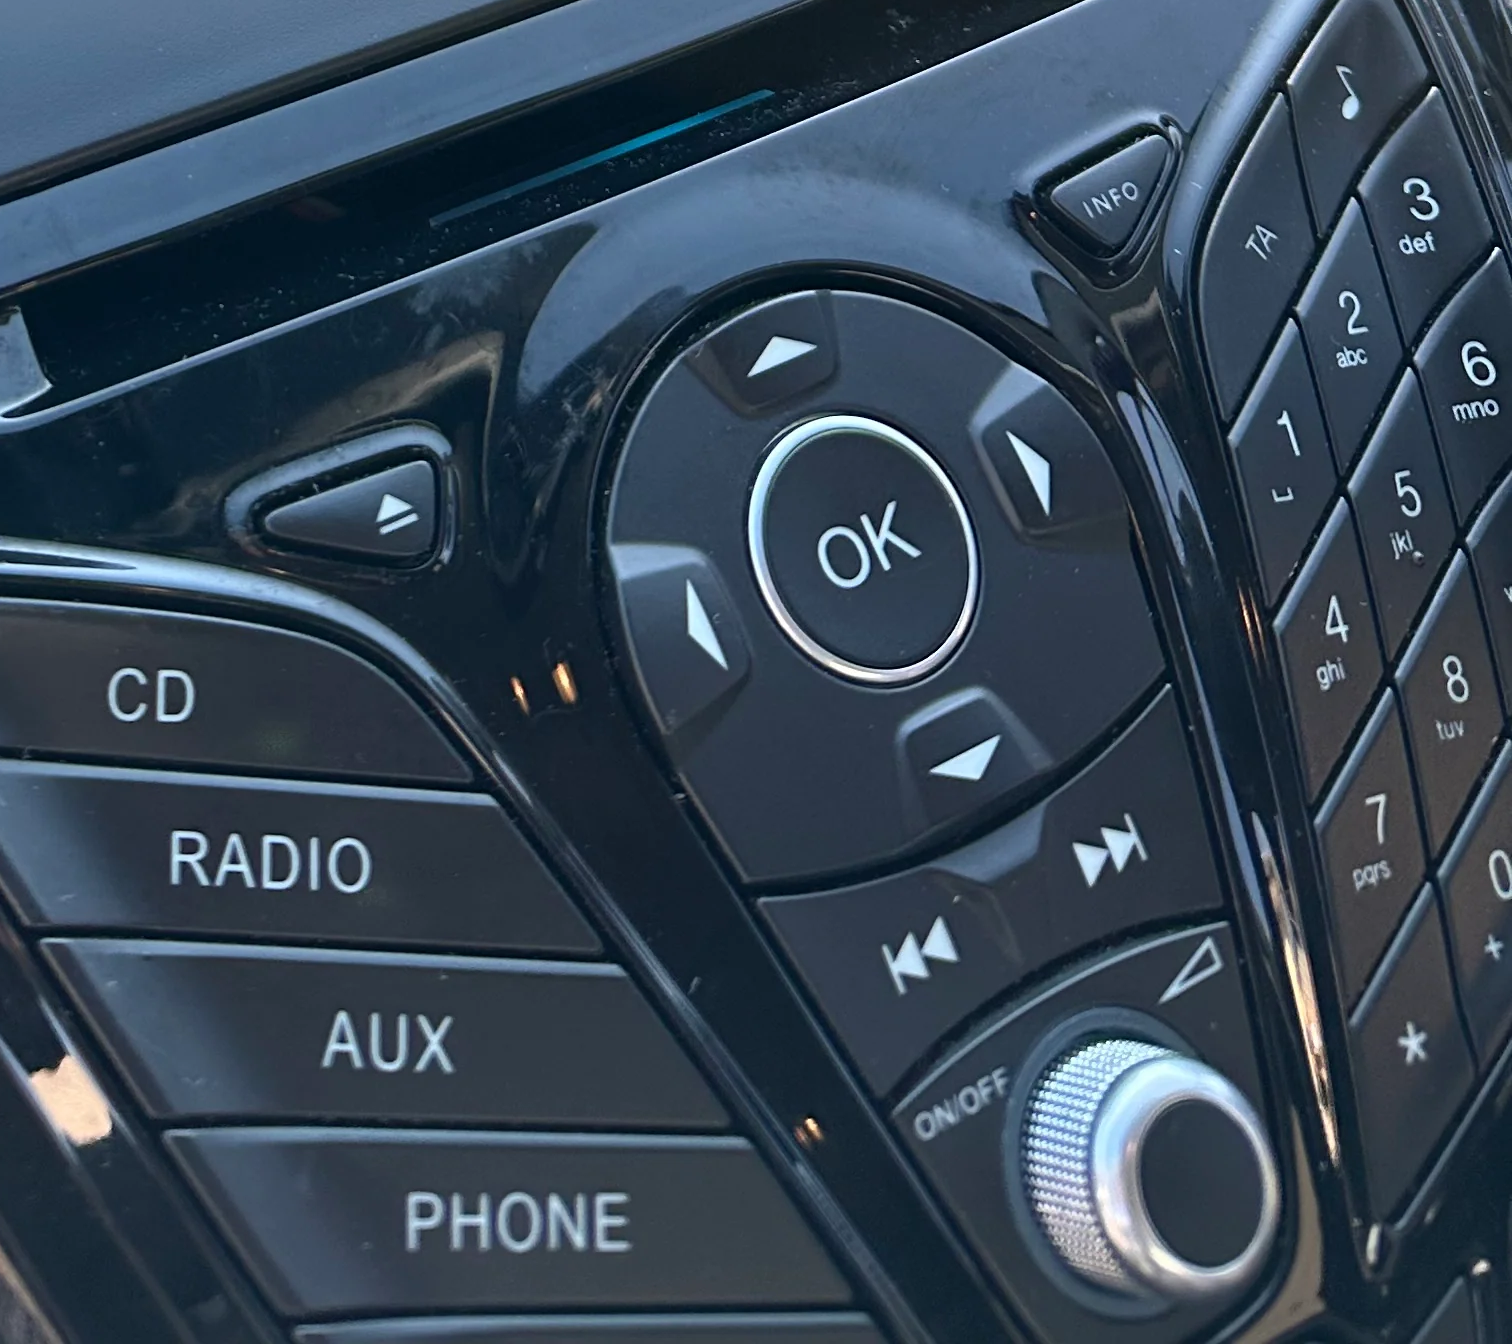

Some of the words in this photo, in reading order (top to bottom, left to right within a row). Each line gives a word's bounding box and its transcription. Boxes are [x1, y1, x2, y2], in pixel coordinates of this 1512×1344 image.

[1082, 180, 1140, 219] INFO
[1402, 177, 1440, 222] 3
[1244, 223, 1279, 261] TA
[1399, 230, 1435, 255] def
[1338, 290, 1369, 335] 2
[1336, 347, 1369, 369] abc
[1460, 340, 1497, 387] 6
[1276, 409, 1301, 457] 1
[1451, 398, 1500, 423] mno
[1394, 469, 1423, 518] 5
[817, 500, 923, 589] OK
[1389, 529, 1414, 561] jkl
[1324, 594, 1349, 643] 4
[106, 666, 197, 724] CD
[1316, 657, 1346, 691] ghi
[1442, 654, 1470, 704] 8
[1435, 719, 1466, 741] tuv
[1364, 792, 1387, 845] 7
[168, 830, 374, 894] RADIO
[1352, 859, 1393, 892] pqrs
[321, 1010, 455, 1074] AUX
[914, 1066, 1008, 1141] ON/OFF
[406, 1191, 633, 1254] PHONE
